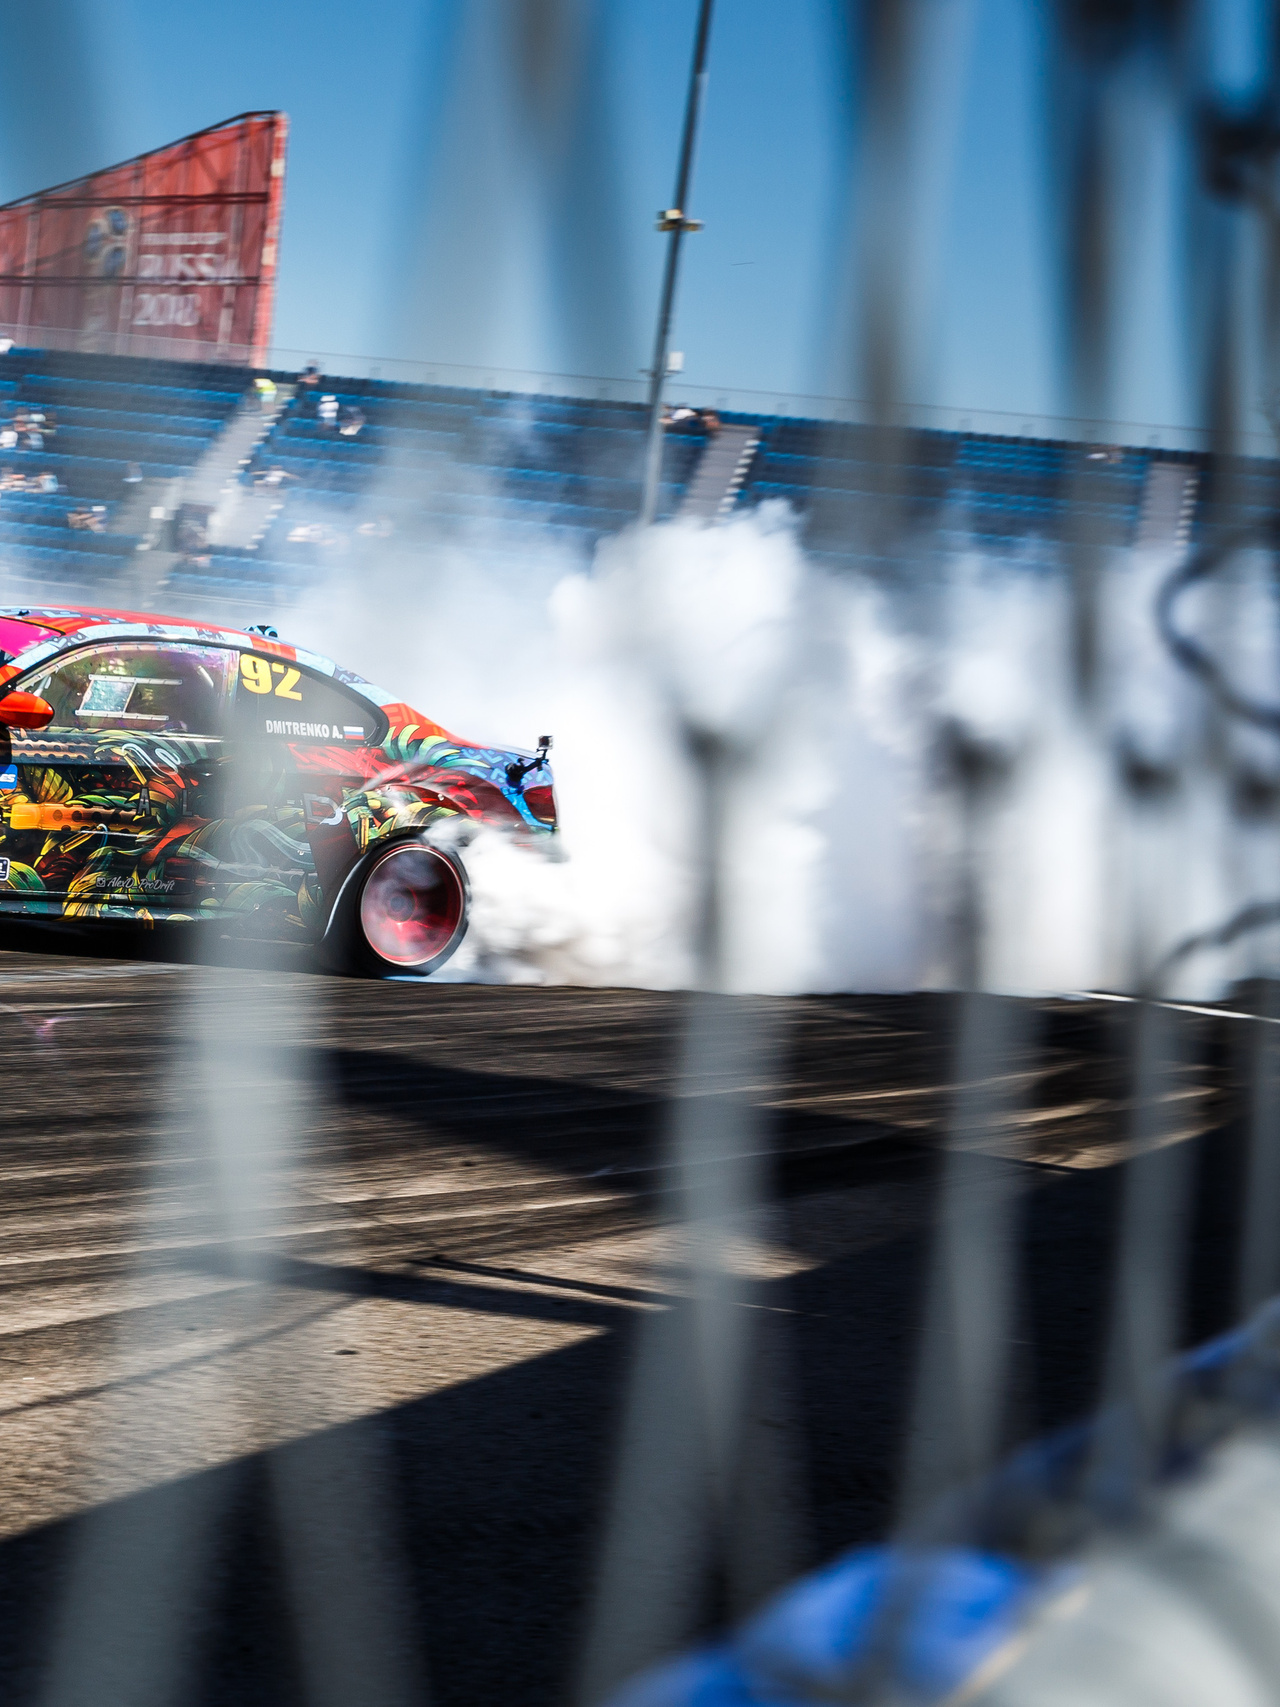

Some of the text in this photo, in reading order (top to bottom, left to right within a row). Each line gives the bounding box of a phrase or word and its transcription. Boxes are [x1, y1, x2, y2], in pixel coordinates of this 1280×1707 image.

[239, 653, 303, 701] 92
[265, 720, 343, 739] DMITRENKO A.
